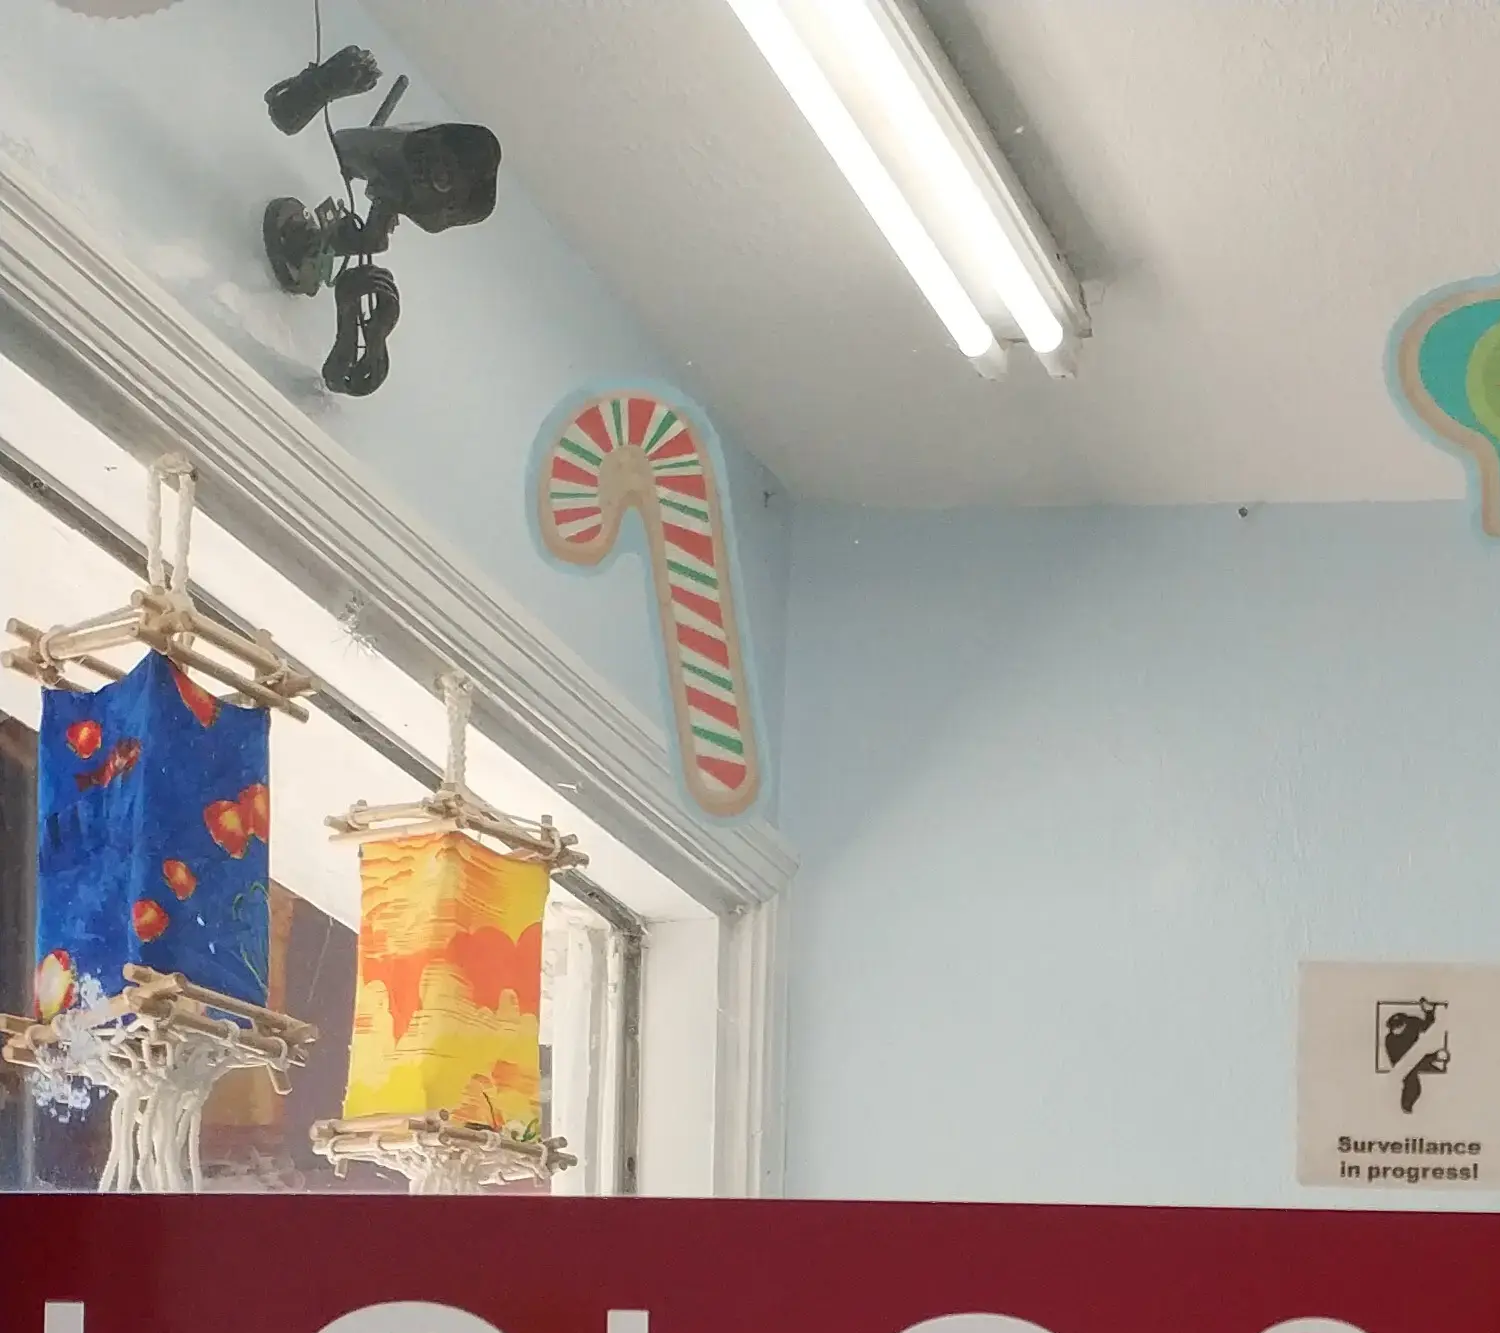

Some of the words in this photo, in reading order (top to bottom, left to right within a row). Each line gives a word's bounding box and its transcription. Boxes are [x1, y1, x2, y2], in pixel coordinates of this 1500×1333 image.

[1338, 1136, 1481, 1155] Surveillance
[1341, 1161, 1360, 1178] in
[1368, 1163, 1479, 1183] progress!
